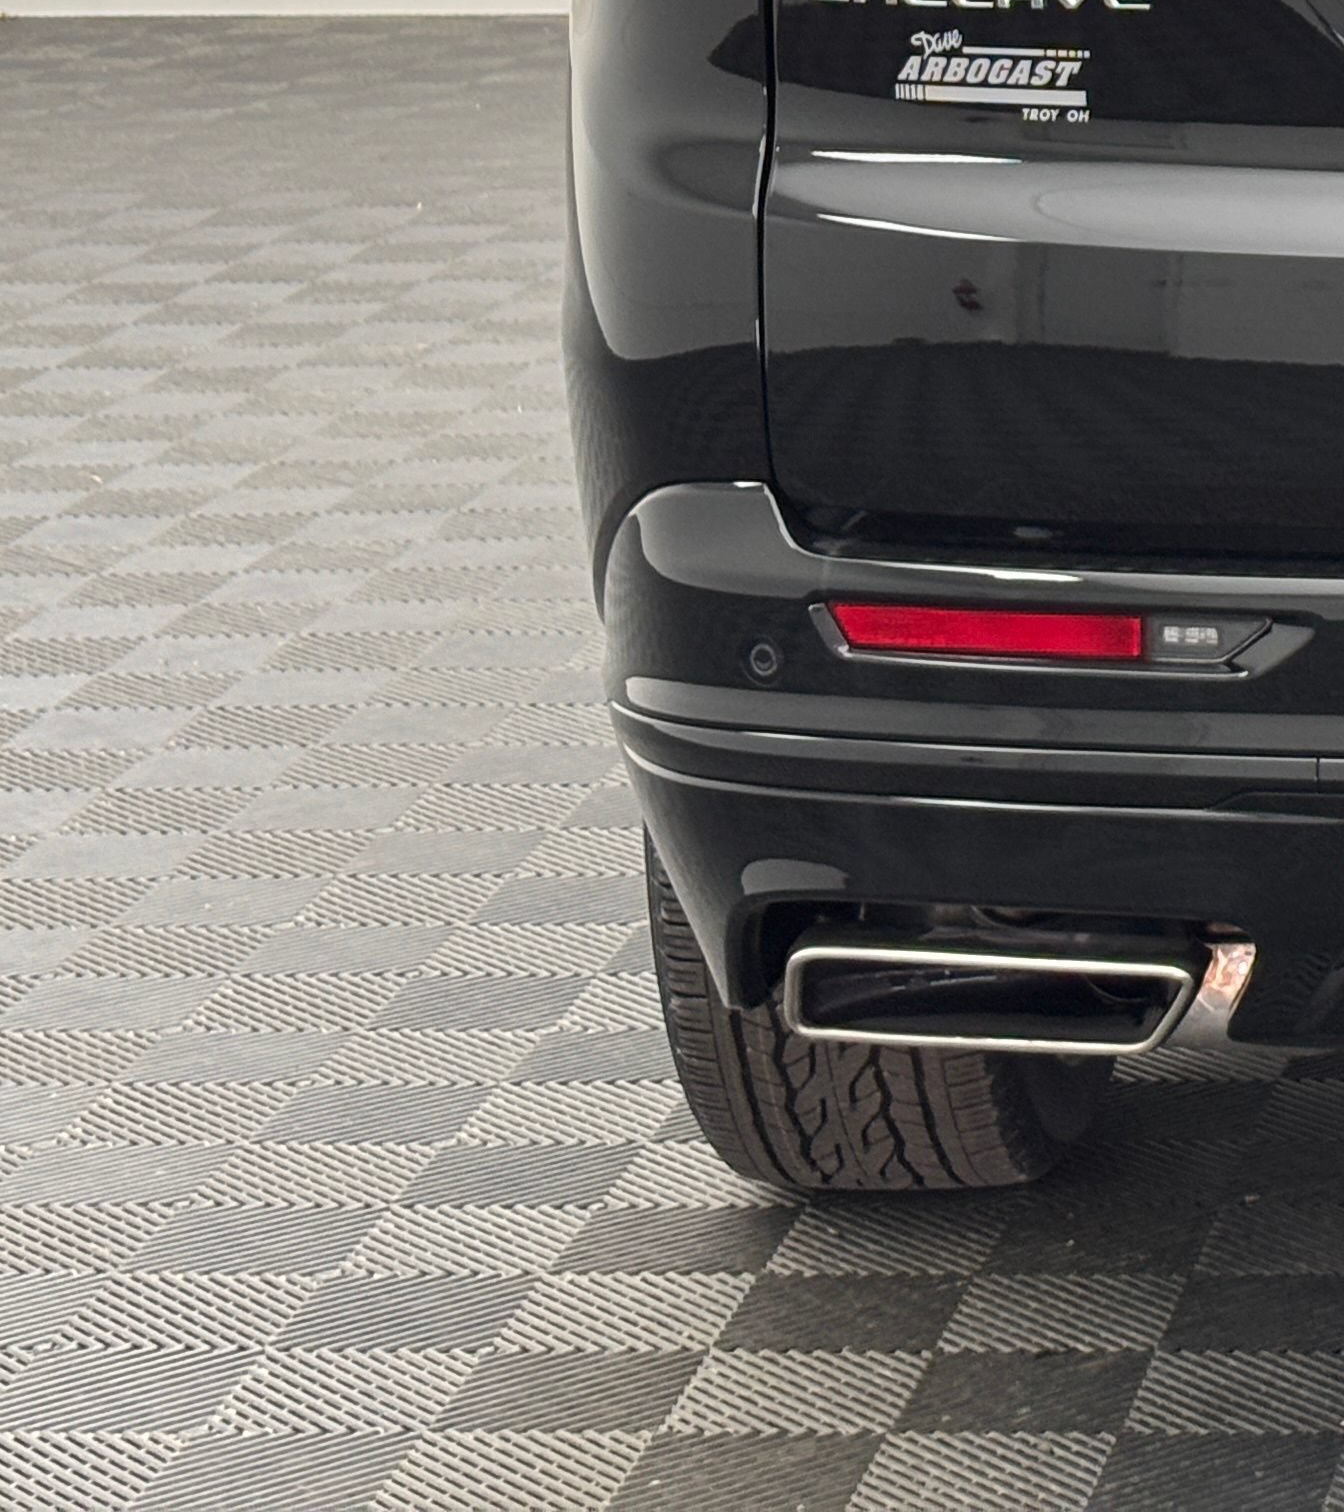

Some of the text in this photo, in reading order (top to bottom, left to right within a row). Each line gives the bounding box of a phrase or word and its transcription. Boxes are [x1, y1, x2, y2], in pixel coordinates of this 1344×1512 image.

[911, 29, 962, 59] Dave
[898, 55, 1083, 87] ARBOGAST
[1022, 108, 1090, 122] TROY OH
